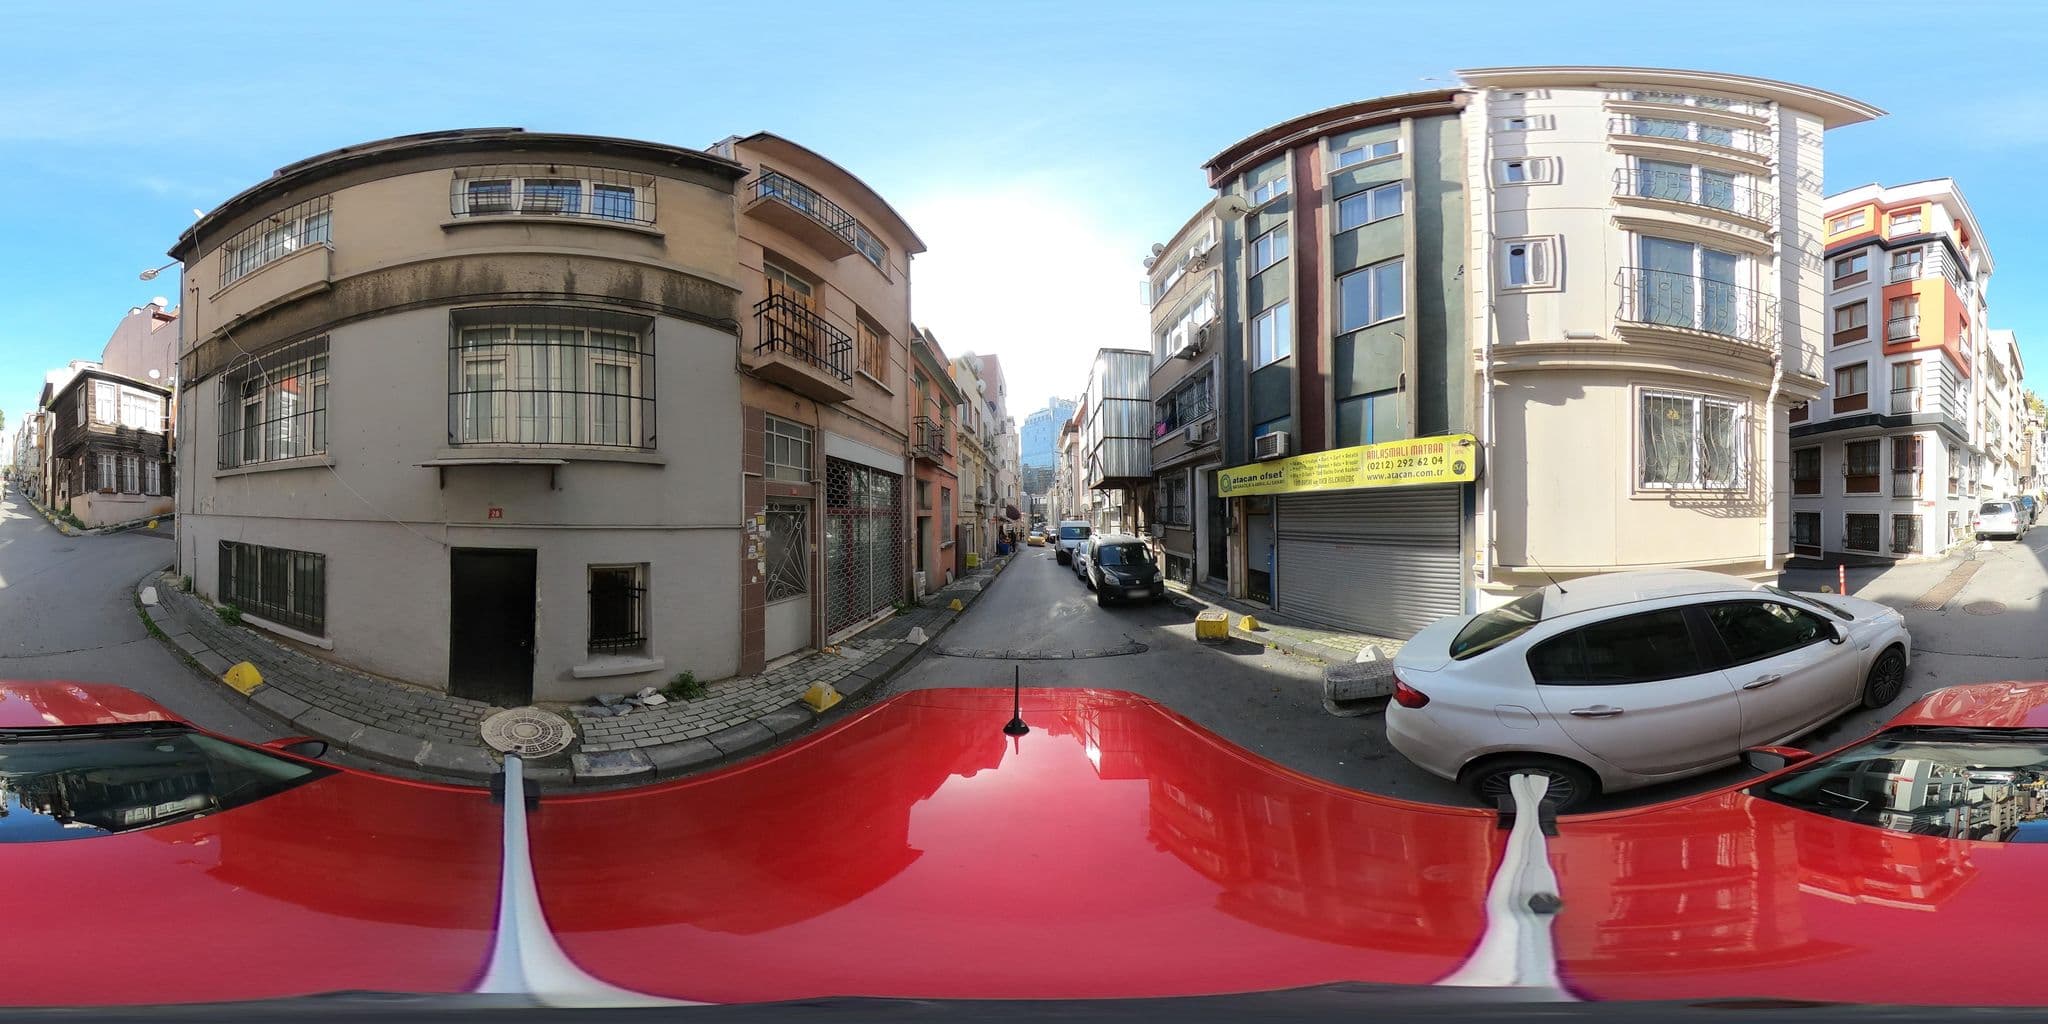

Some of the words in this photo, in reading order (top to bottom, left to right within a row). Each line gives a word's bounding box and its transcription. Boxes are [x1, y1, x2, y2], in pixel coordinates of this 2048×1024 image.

[1410, 443, 1444, 455] MATBAA
[1367, 460, 1394, 471] (0212)
[1397, 458, 1414, 468] 292
[1417, 457, 1428, 466] 62
[1431, 456, 1443, 465] 04
[1232, 474, 1257, 484] atacan
[1260, 470, 1283, 480] ofset
[1367, 469, 1444, 480] www.atacan.com.tr
